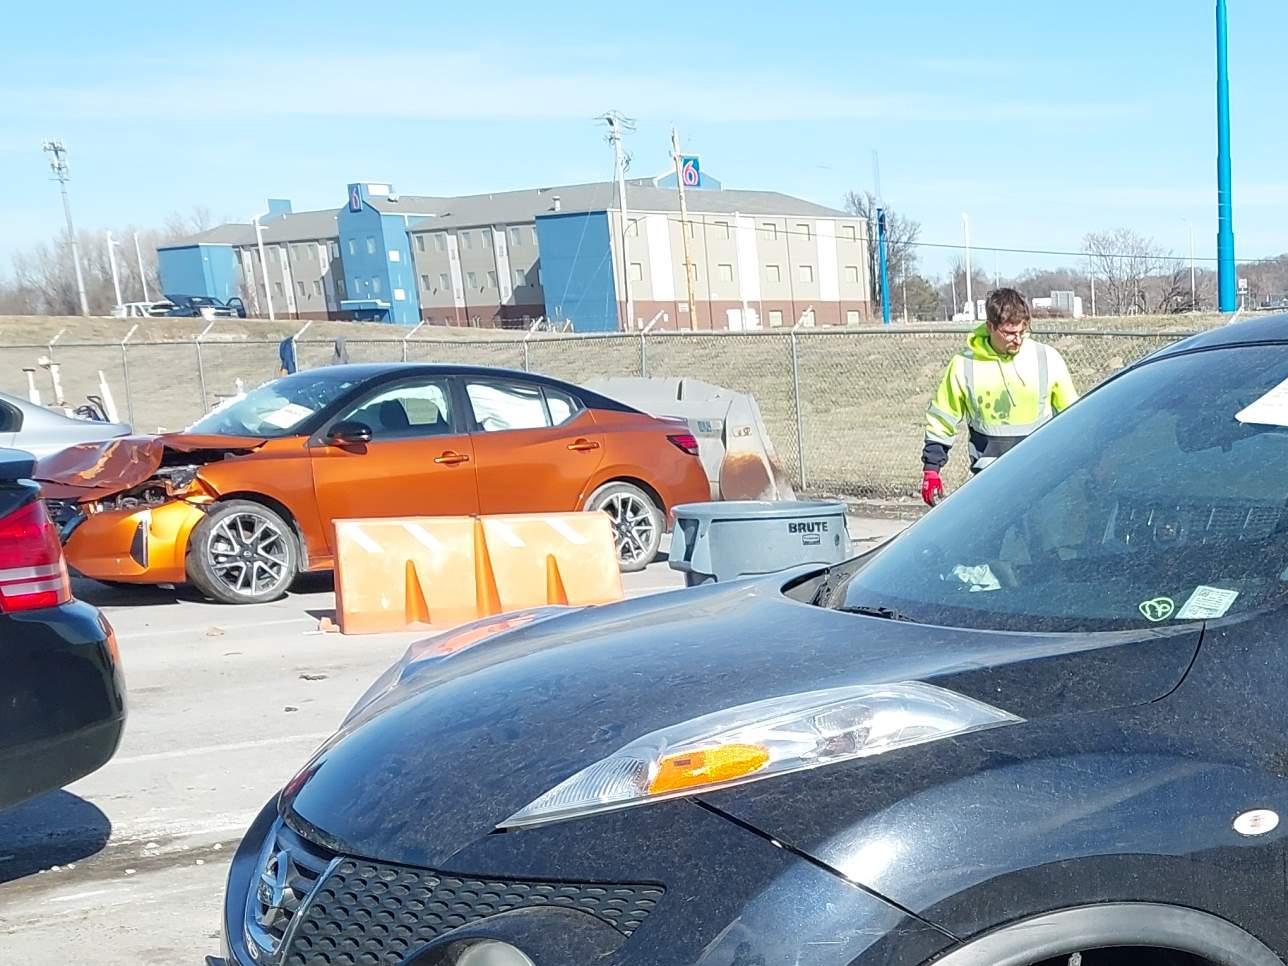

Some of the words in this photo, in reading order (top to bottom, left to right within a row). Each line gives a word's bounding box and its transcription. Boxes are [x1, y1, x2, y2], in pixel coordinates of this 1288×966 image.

[682, 159, 699, 186] 6
[351, 187, 360, 210] 6
[788, 521, 828, 534] BRUTE
